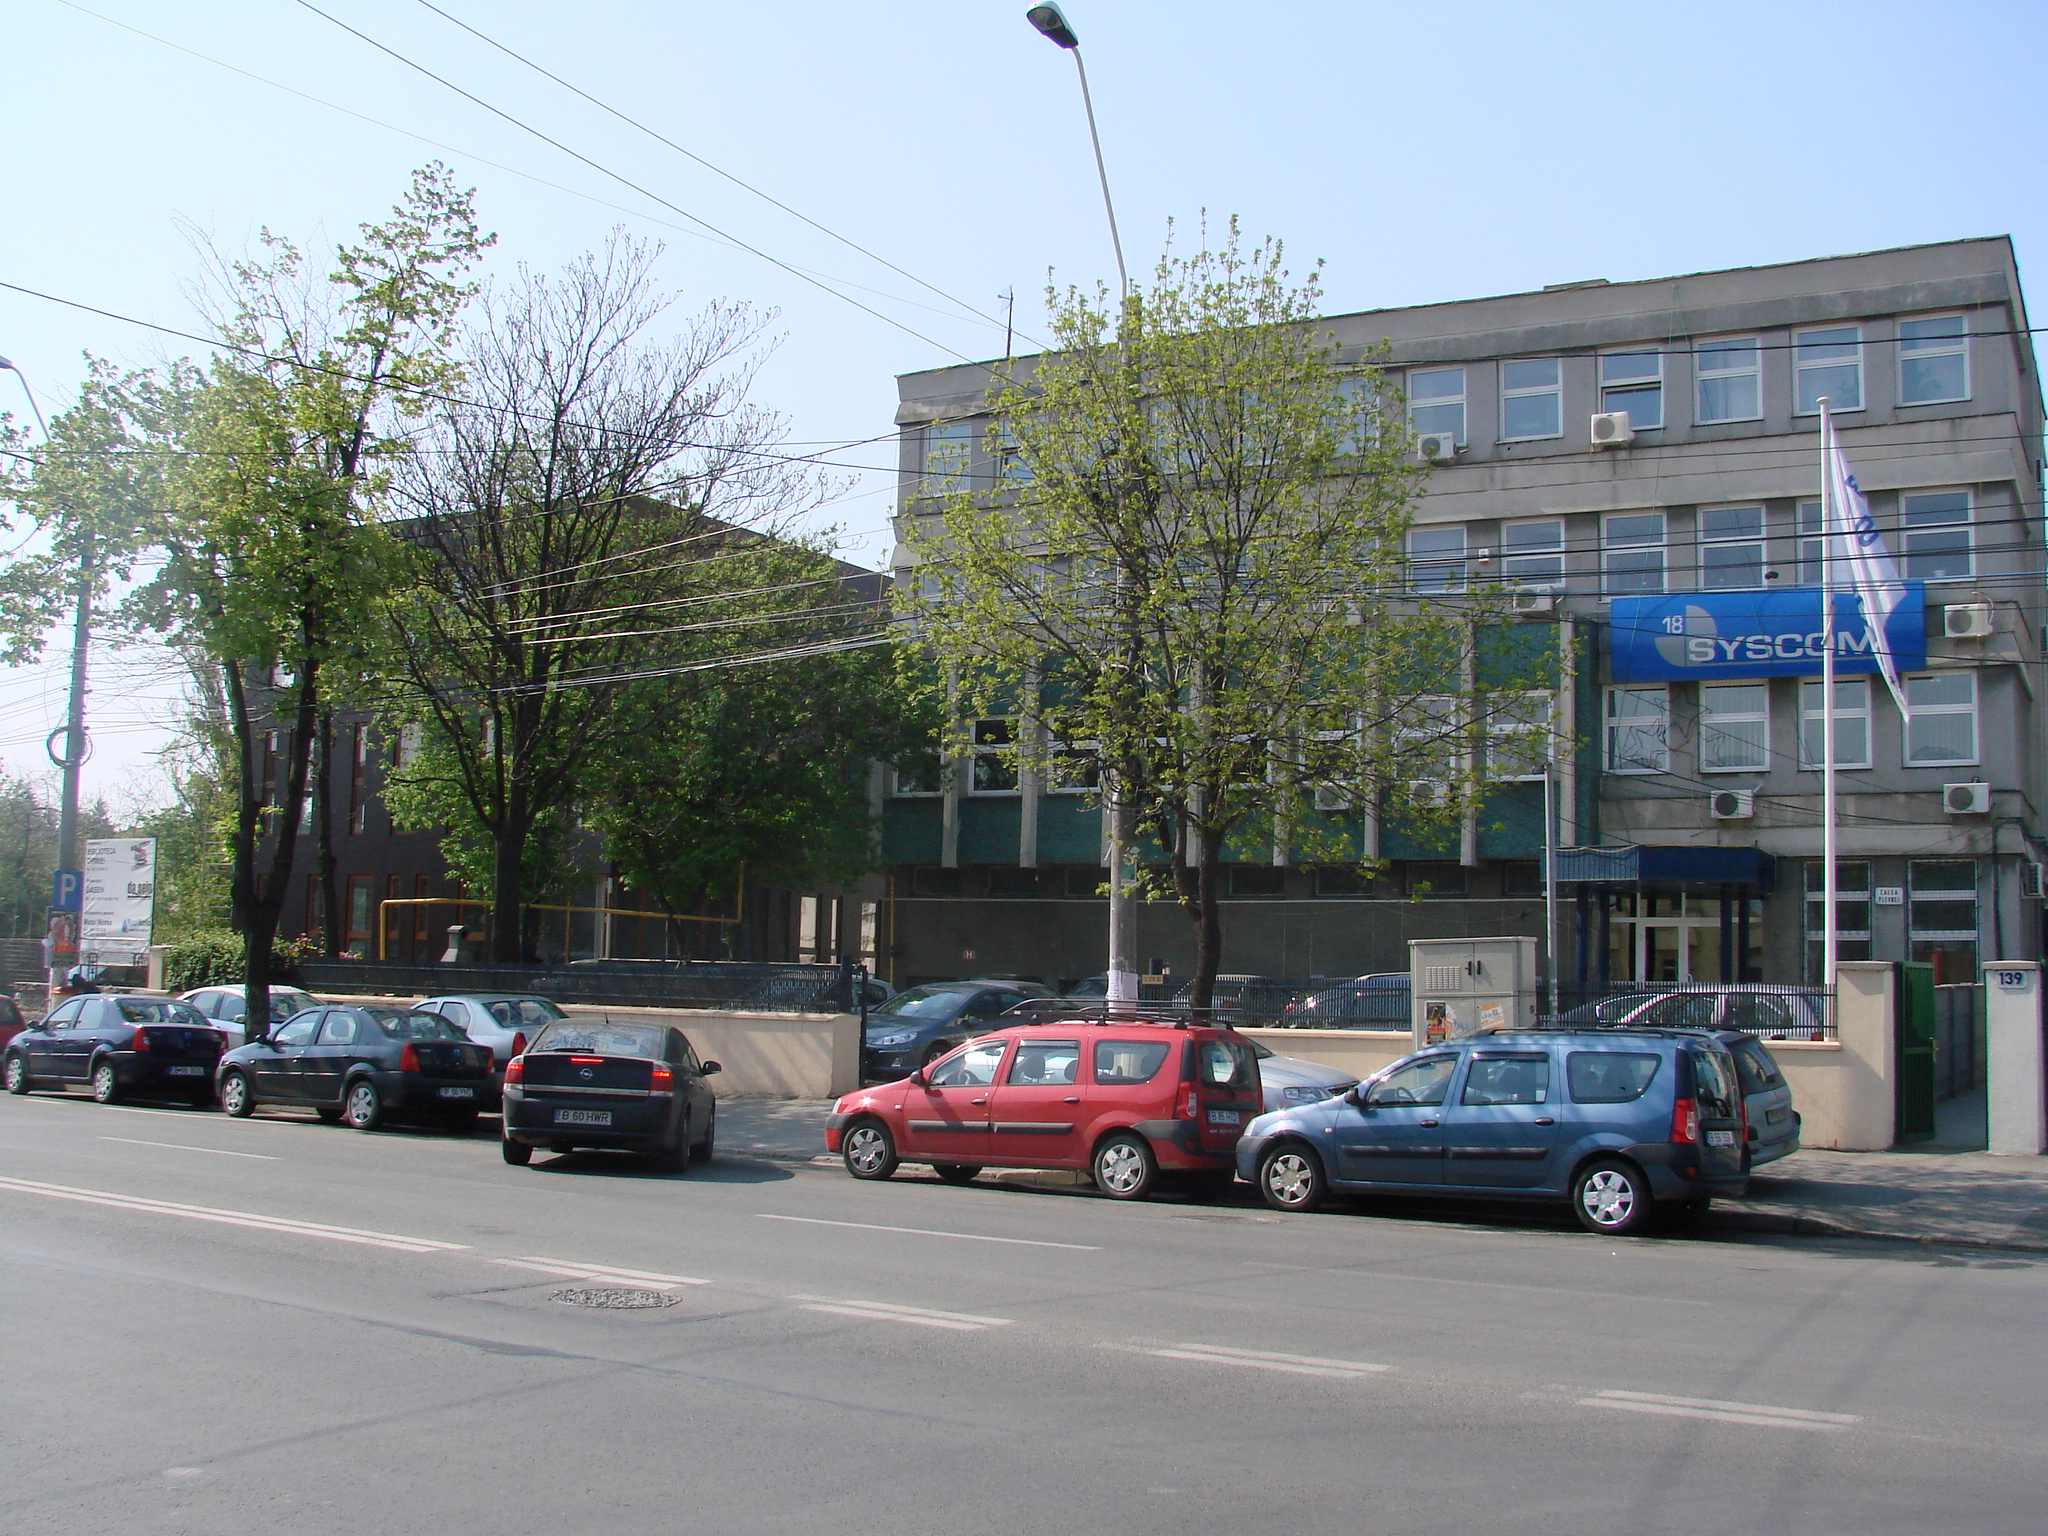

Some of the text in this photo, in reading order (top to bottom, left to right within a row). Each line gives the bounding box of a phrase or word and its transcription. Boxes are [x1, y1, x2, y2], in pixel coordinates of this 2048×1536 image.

[1662, 615, 1683, 634] 18
[1688, 631, 1872, 662] SYSCOM
[61, 874, 76, 906] P
[1999, 972, 2022, 985] 139
[562, 1111, 608, 1122] B 60 HWR
